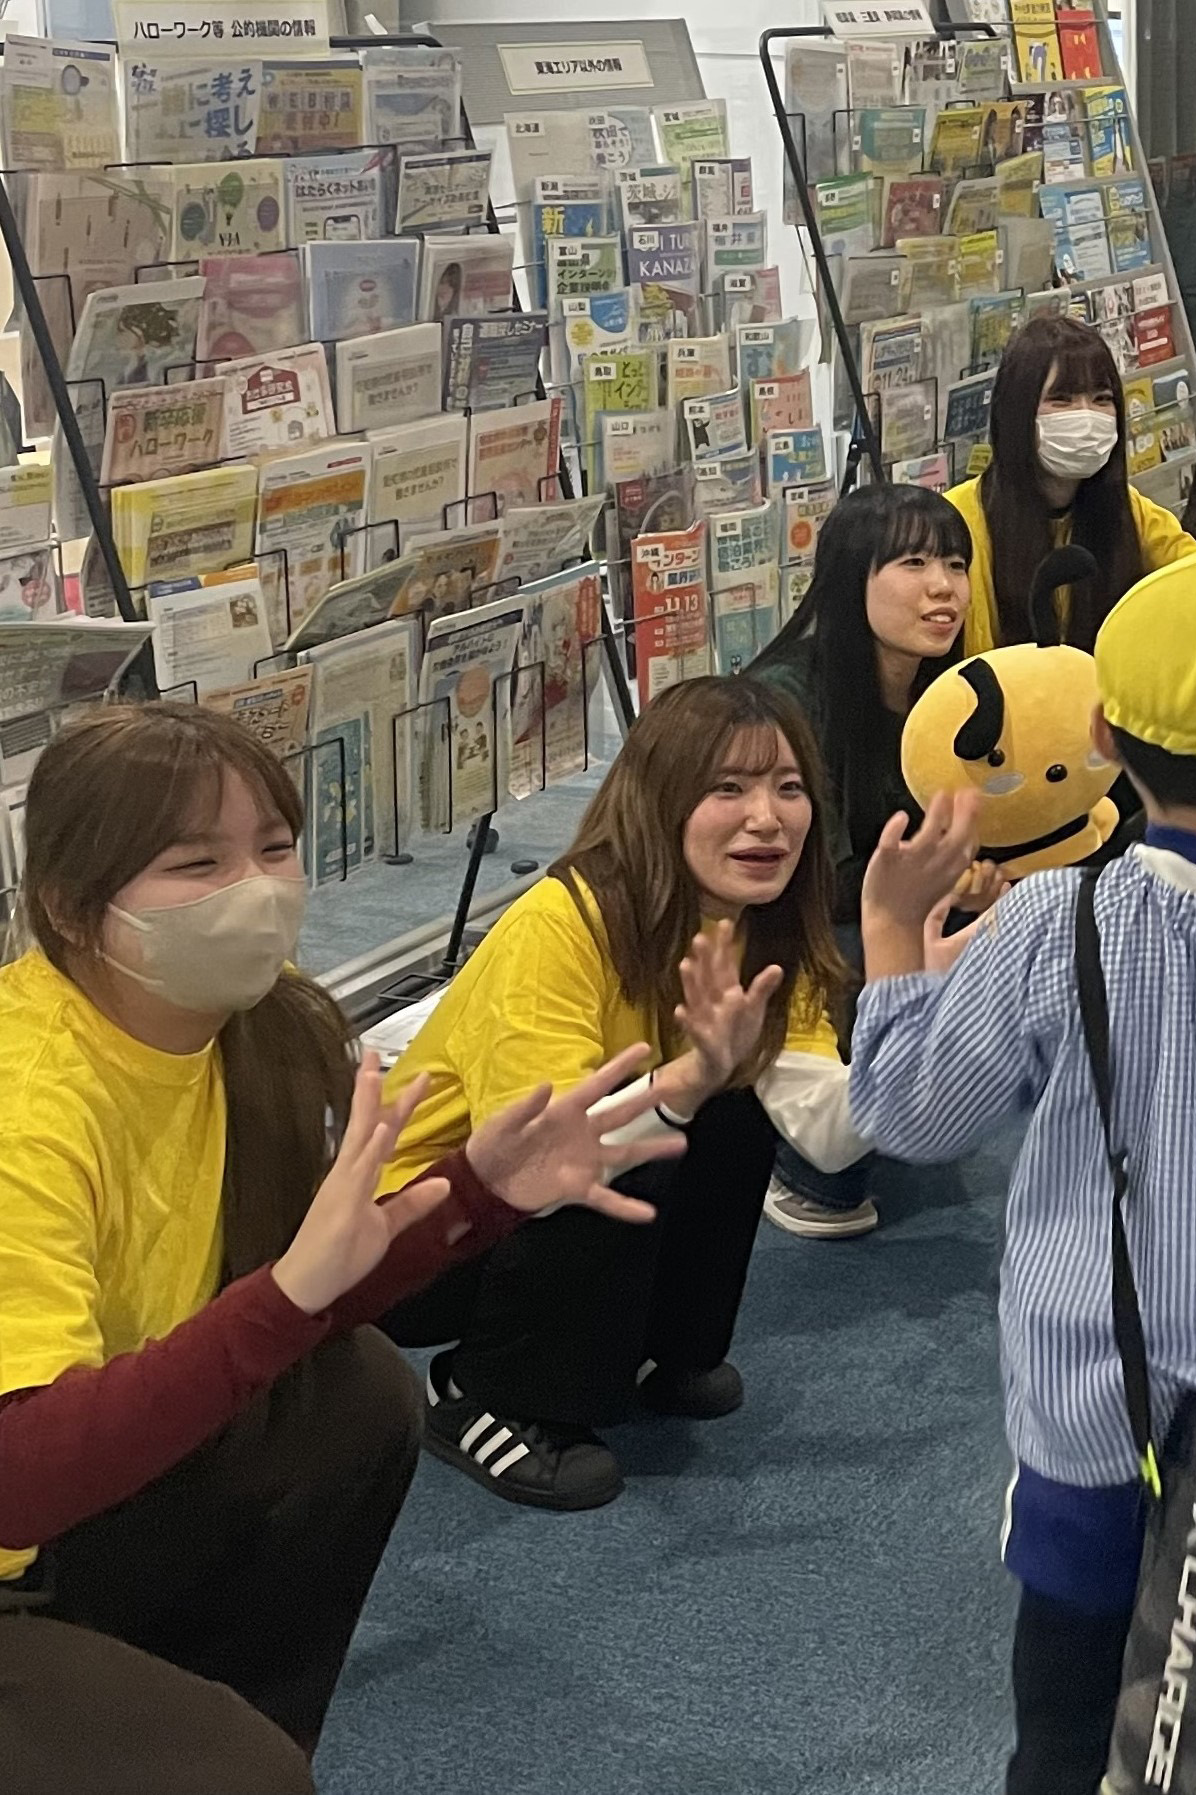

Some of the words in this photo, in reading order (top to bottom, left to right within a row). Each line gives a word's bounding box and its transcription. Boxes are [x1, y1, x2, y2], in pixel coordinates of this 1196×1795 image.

[134, 20, 224, 39] ハローワーク等
[231, 19, 316, 38] 公的機関の情報
[611, 421, 629, 431] 山口
